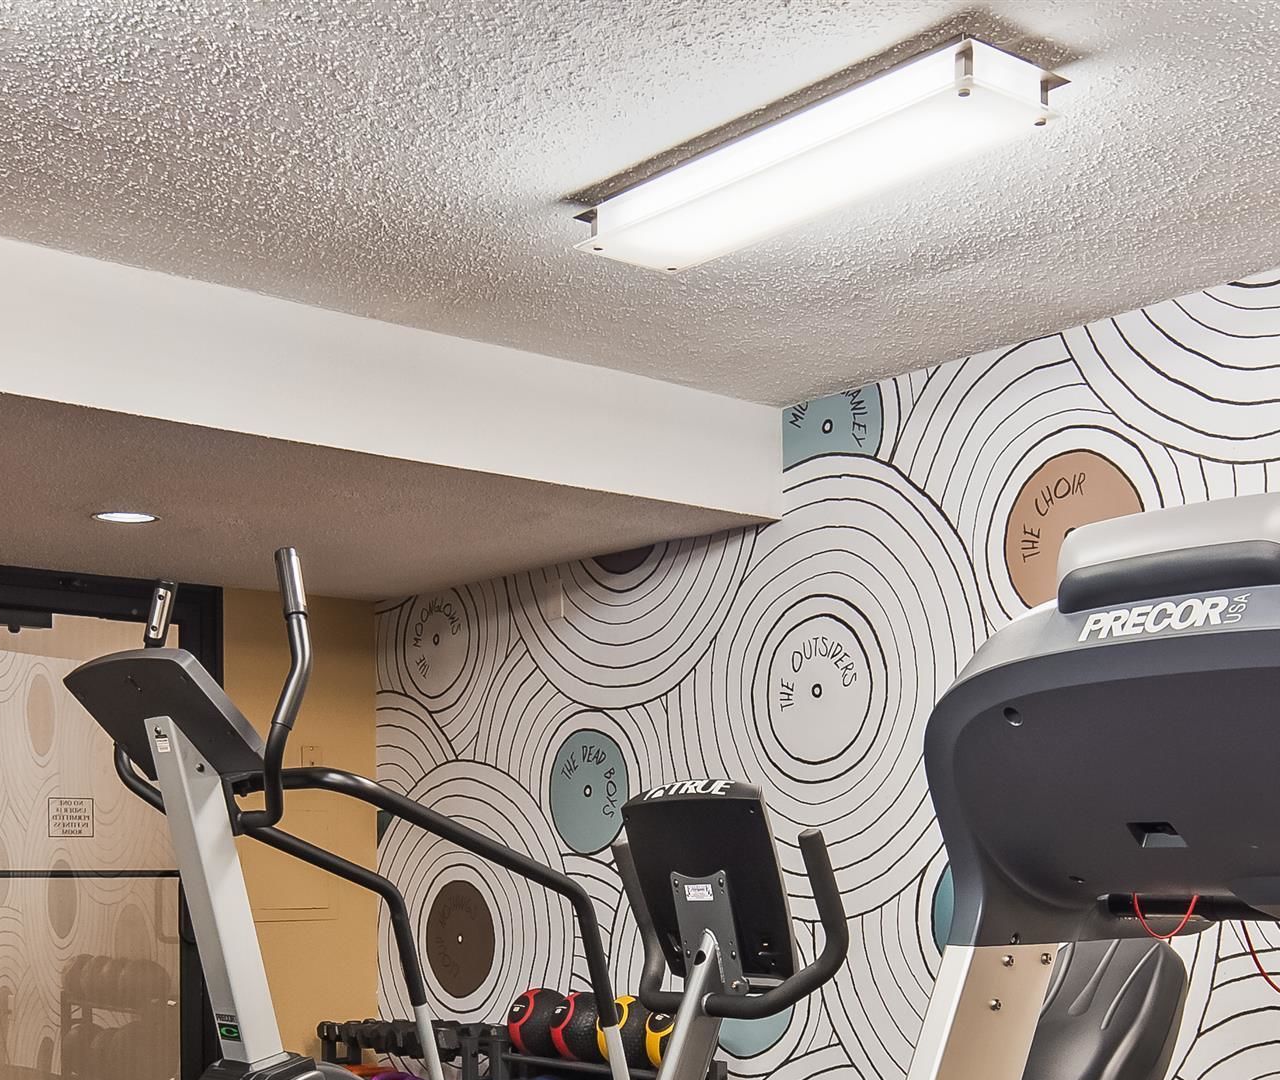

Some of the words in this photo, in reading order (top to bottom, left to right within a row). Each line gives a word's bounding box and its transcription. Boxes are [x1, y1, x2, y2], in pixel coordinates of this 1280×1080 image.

[840, 388, 868, 448] ANLEY
[1021, 523, 1041, 563] THE
[1035, 472, 1086, 517] CHOIR
[413, 597, 461, 648] MOONGLOWS
[1078, 596, 1229, 642] PRECOR
[1223, 592, 1252, 624] USA
[415, 654, 430, 679] THE
[779, 677, 794, 712] THE
[791, 636, 857, 687] OUTSIDERS
[560, 752, 579, 780] THE
[581, 745, 607, 766] DEAD
[602, 767, 617, 818] BOYS
[668, 779, 735, 796] TRUE
